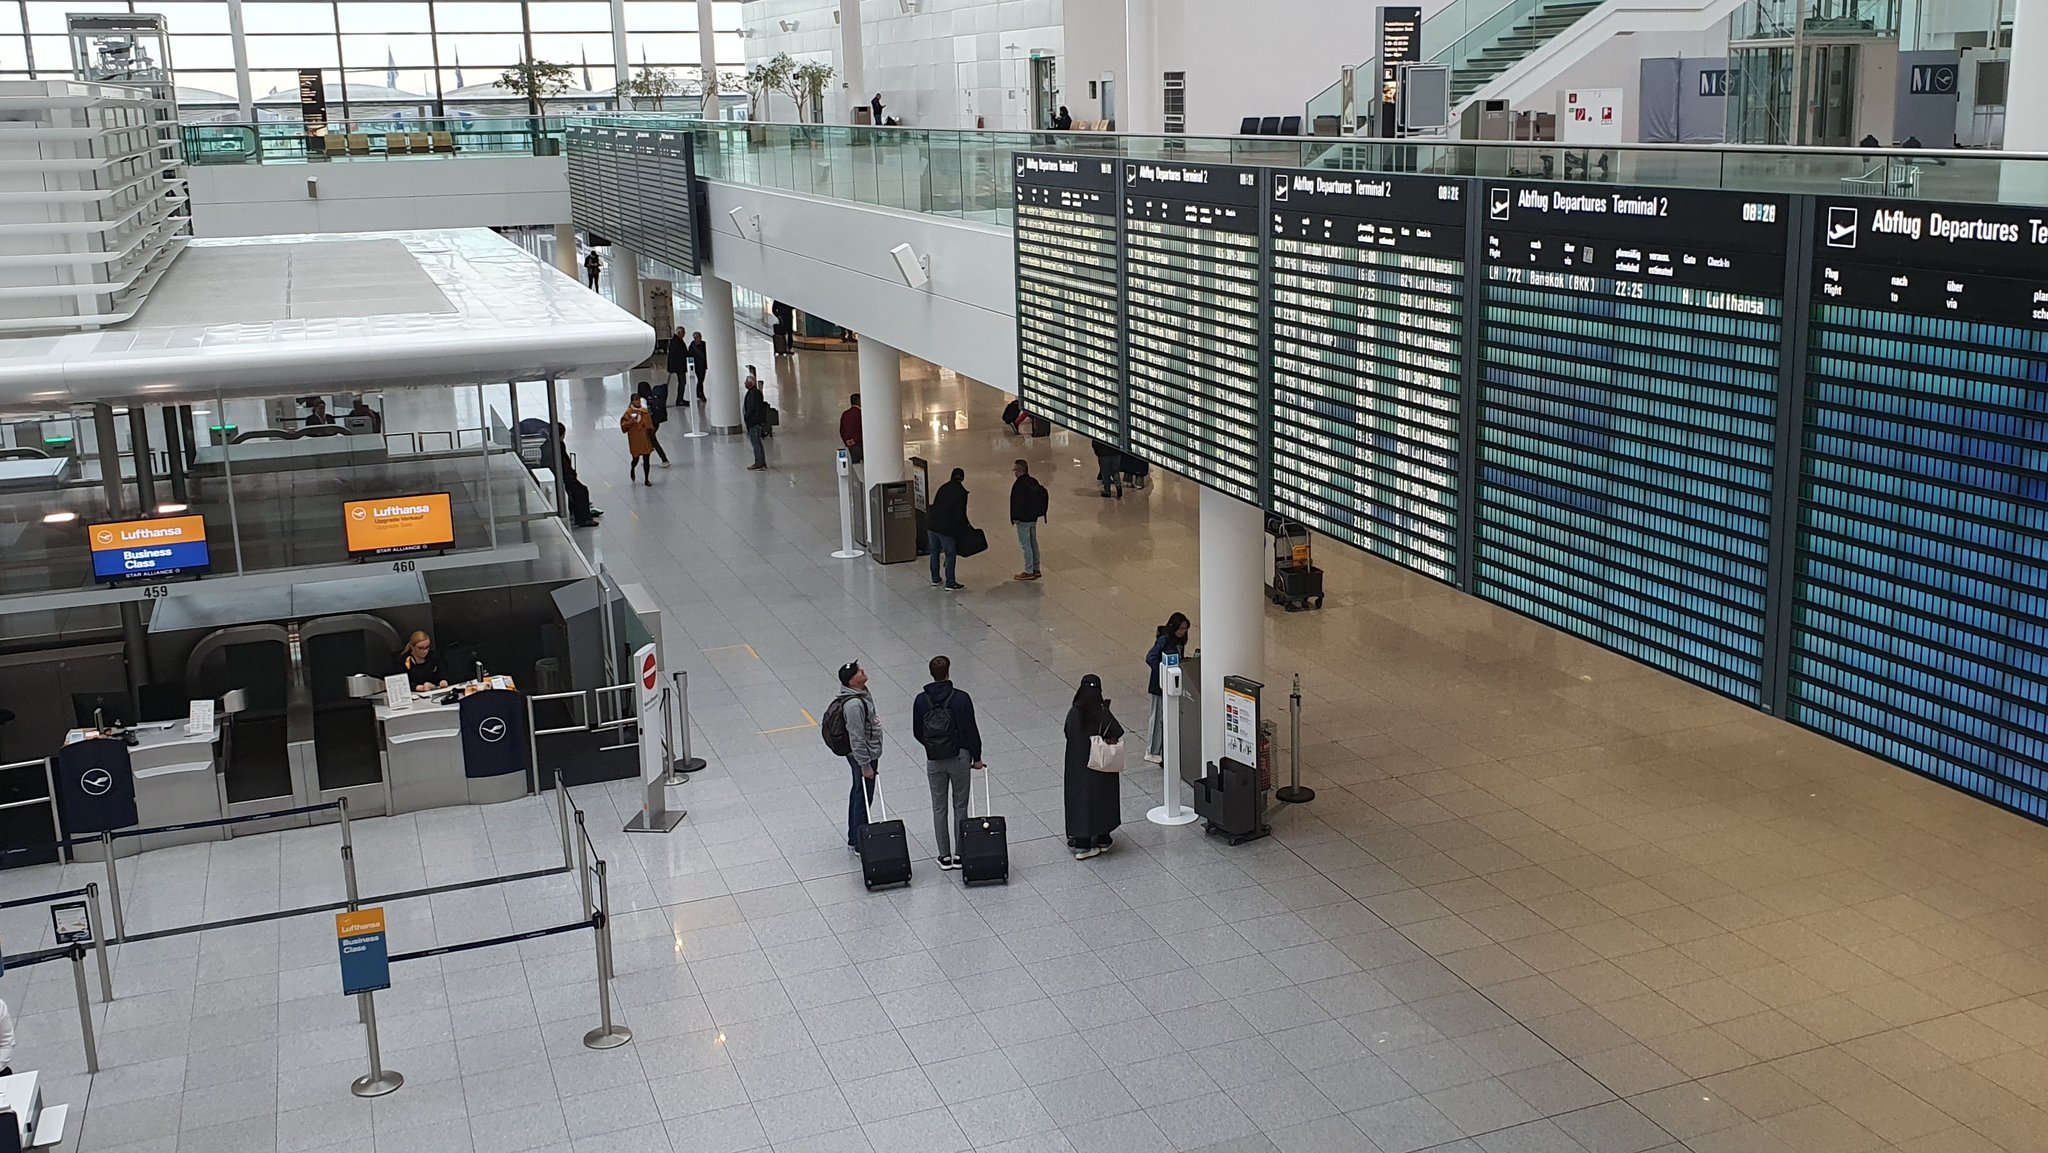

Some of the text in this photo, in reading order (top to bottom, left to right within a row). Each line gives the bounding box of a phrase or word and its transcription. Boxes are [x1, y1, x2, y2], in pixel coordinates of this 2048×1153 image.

[1701, 73, 1716, 94] M
[1912, 67, 1932, 92] M
[1294, 176, 1391, 197] Abflug Departures Terminal 2
[1518, 190, 1668, 217] Abflug Departures Terminal 2
[1743, 203, 1776, 223] 08:28
[1872, 209, 1921, 240] Abflug
[1930, 213, 2019, 243] Departures
[1302, 242, 1320, 256] London
[1358, 250, 1375, 263] 16:00
[1415, 257, 1451, 274] Lufthansa
[1684, 254, 1696, 265] Gate
[1301, 260, 1327, 274] Brussels
[1358, 268, 1375, 282] 16:05
[1415, 276, 1451, 293] Lufthansa
[1825, 268, 1963, 293] Flug nach über
[1317, 279, 1334, 293] (FCO)
[1357, 286, 1375, 300] 17:25
[1415, 295, 1450, 313] Lufthansa
[1507, 268, 1521, 283] 772
[1530, 270, 1564, 288] Bangkok
[1568, 274, 1595, 293] (BKK)
[1616, 281, 1643, 299] 22:25
[1706, 291, 1764, 315] Lufthansa
[1824, 284, 1958, 310] Flight to via
[1301, 294, 1330, 310] Amsterdam
[1357, 304, 1374, 318] 17:30
[1414, 314, 1450, 332] Lufthansa
[1301, 312, 1326, 327] Brussels
[1356, 322, 1374, 337] 18:00
[1414, 333, 1450, 352] Lufthansa
[1301, 328, 1317, 343] Milan
[1356, 340, 1373, 355] 18:15
[1414, 352, 1449, 372] Lufthansa
[1356, 358, 1373, 373] 18:25
[1356, 376, 1373, 391] 18:40
[1412, 389, 1448, 410] Lufthansa
[1300, 395, 1313, 409] Riga
[1355, 410, 1372, 426] 19:10
[1412, 426, 1447, 447] Lufthansa
[1355, 392, 1372, 408] 19:05
[1412, 407, 1447, 428] Lufthansa
[1300, 412, 1319, 428] Vienna
[1354, 428, 1372, 444] 19:15
[1411, 444, 1446, 466] Lufthansa
[1300, 428, 1312, 443] Cape
[1316, 433, 1328, 448] Town
[1354, 445, 1372, 461] 19:25
[1411, 462, 1446, 485] Lufthansa
[1300, 445, 1338, 468] Thessaloniki
[1354, 462, 1371, 479] 20:15
[1274, 468, 1280, 481] LX
[1282, 472, 1294, 486] 1111
[1354, 497, 1371, 514] 20:50
[1410, 517, 1445, 541] Lufthansa
[1300, 461, 1328, 481] Barcelona
[1354, 480, 1371, 496] 20:50
[1410, 499, 1445, 522] Lufthansa
[373, 505, 429, 517] Lufthansa
[120, 527, 182, 540] Lufthansa
[1300, 494, 1324, 514] Brussels
[1353, 514, 1370, 531] 21:15
[1410, 535, 1444, 559] Lufthansa
[123, 548, 172, 560] Business
[1300, 510, 1318, 528] Vienna
[1353, 531, 1370, 548] 21:35
[1409, 553, 1444, 578] Lufthansa
[125, 560, 155, 569] Class
[392, 561, 415, 573] 460
[144, 586, 168, 598] 459
[342, 923, 380, 933] Lufthansa
[343, 936, 380, 946] Business
[343, 945, 366, 954] Class
